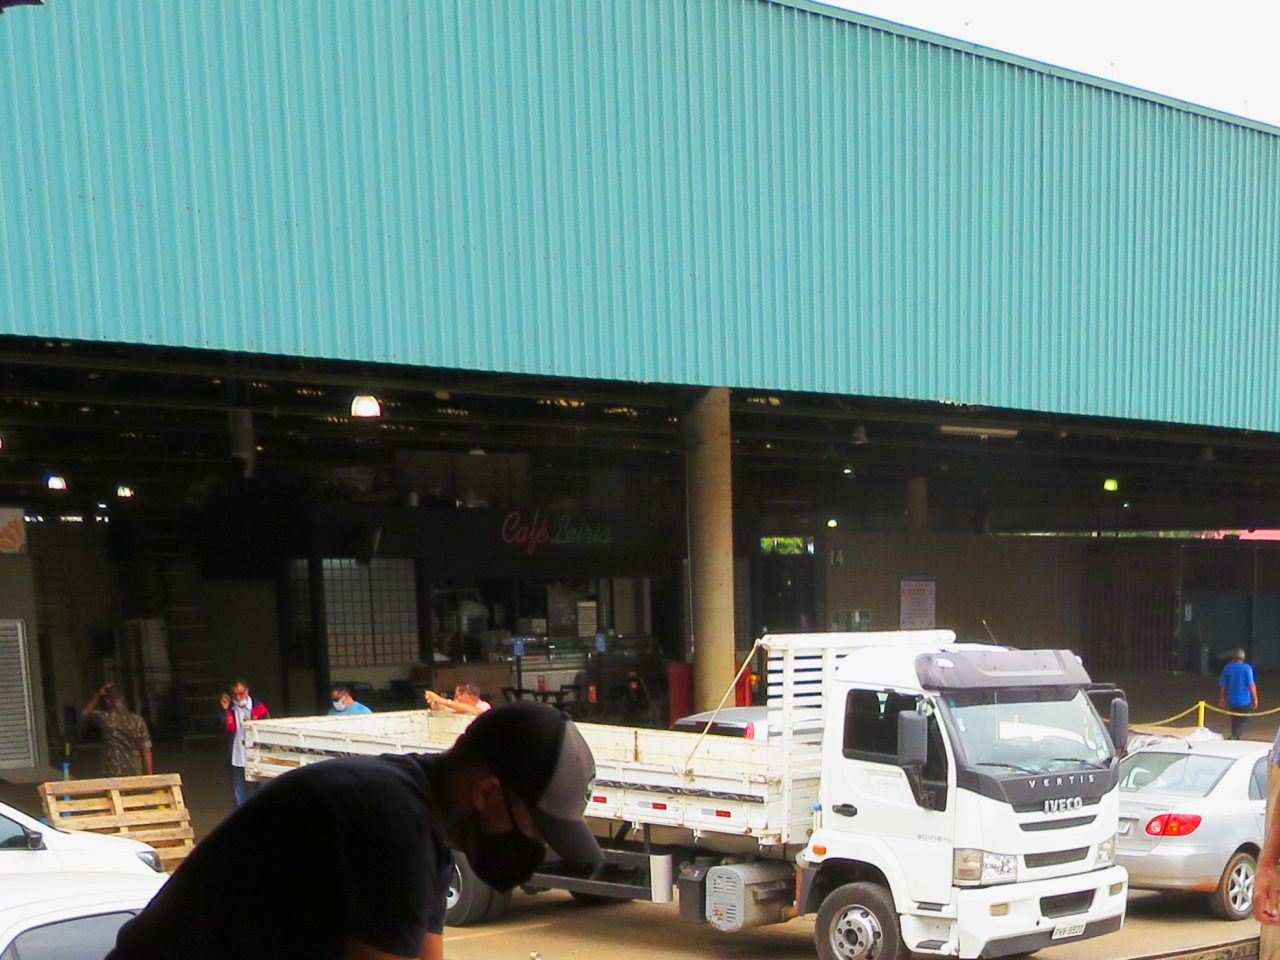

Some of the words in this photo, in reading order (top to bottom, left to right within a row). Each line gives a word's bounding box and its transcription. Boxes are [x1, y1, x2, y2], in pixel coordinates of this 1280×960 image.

[501, 510, 549, 556] Café
[1028, 774, 1095, 788] VERTIS
[1043, 796, 1083, 814] IVECO
